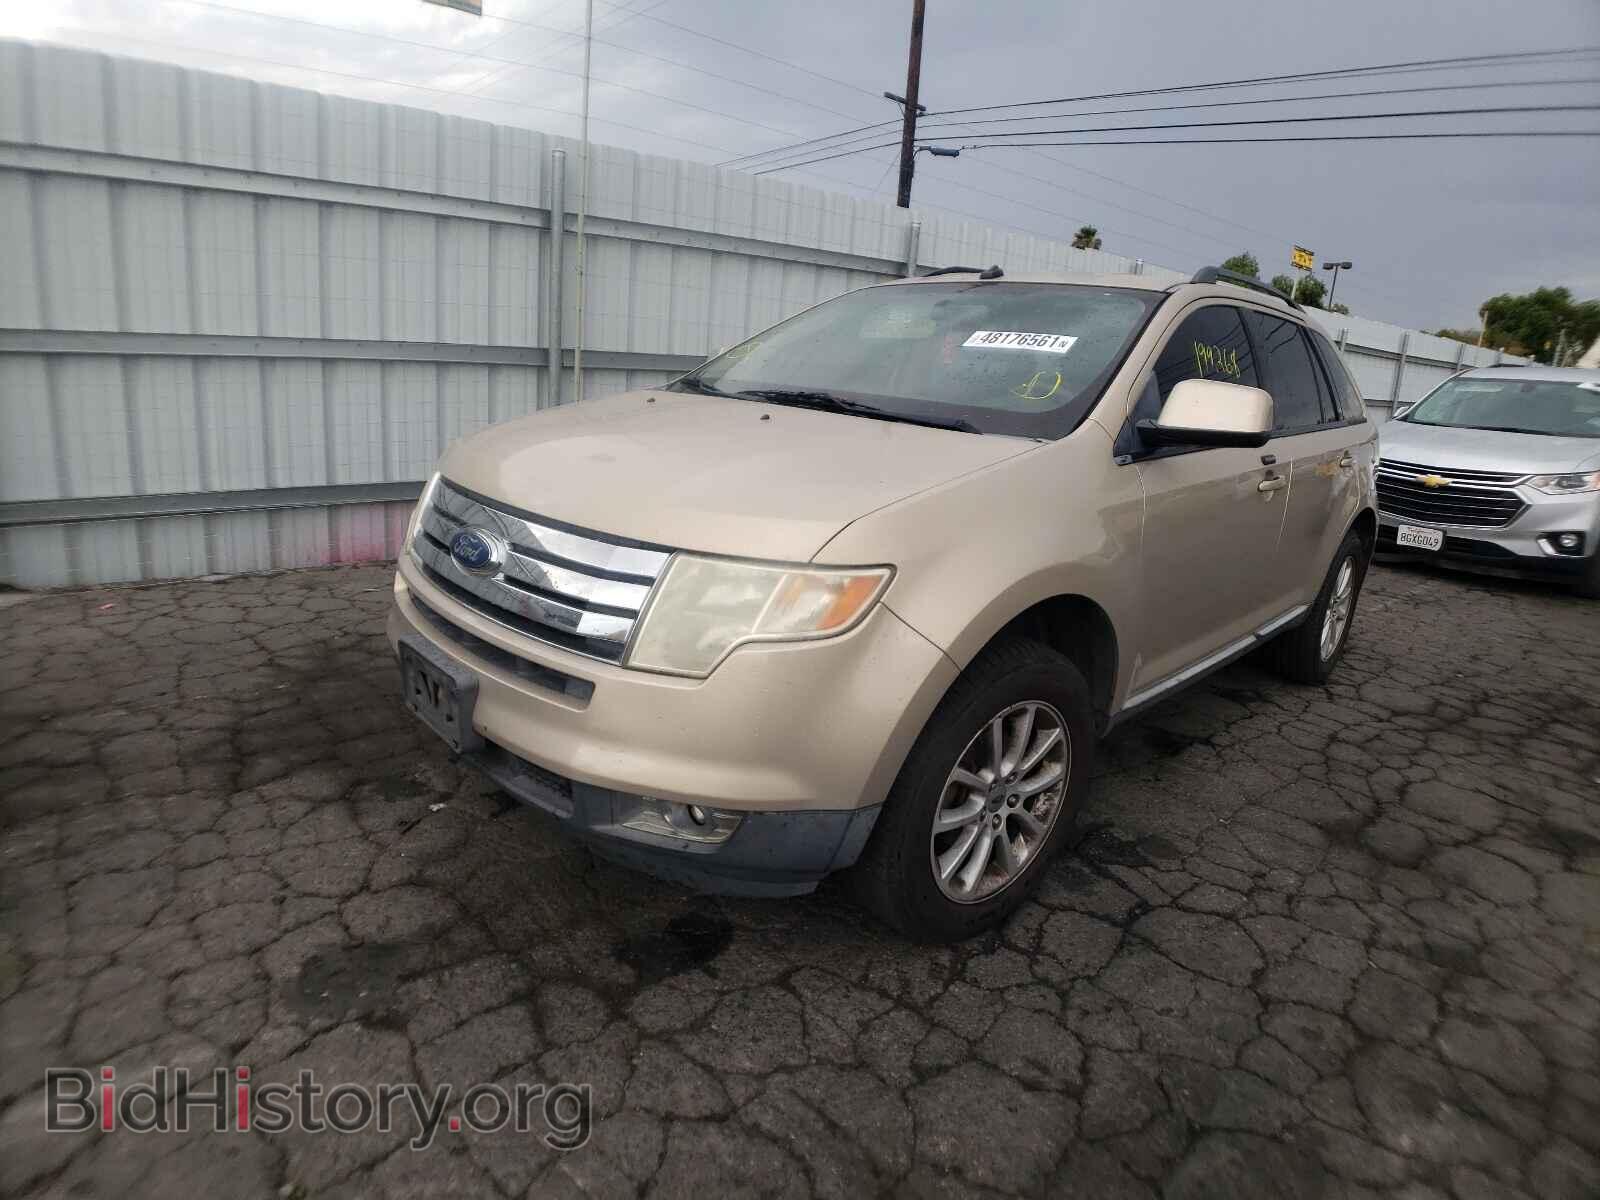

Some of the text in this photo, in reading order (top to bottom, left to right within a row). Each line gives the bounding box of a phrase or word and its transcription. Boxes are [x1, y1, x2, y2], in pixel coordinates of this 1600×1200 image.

[979, 332, 1060, 348] 48176561
[453, 534, 484, 562] Ford
[1400, 532, 1439, 549] 8GXG049
